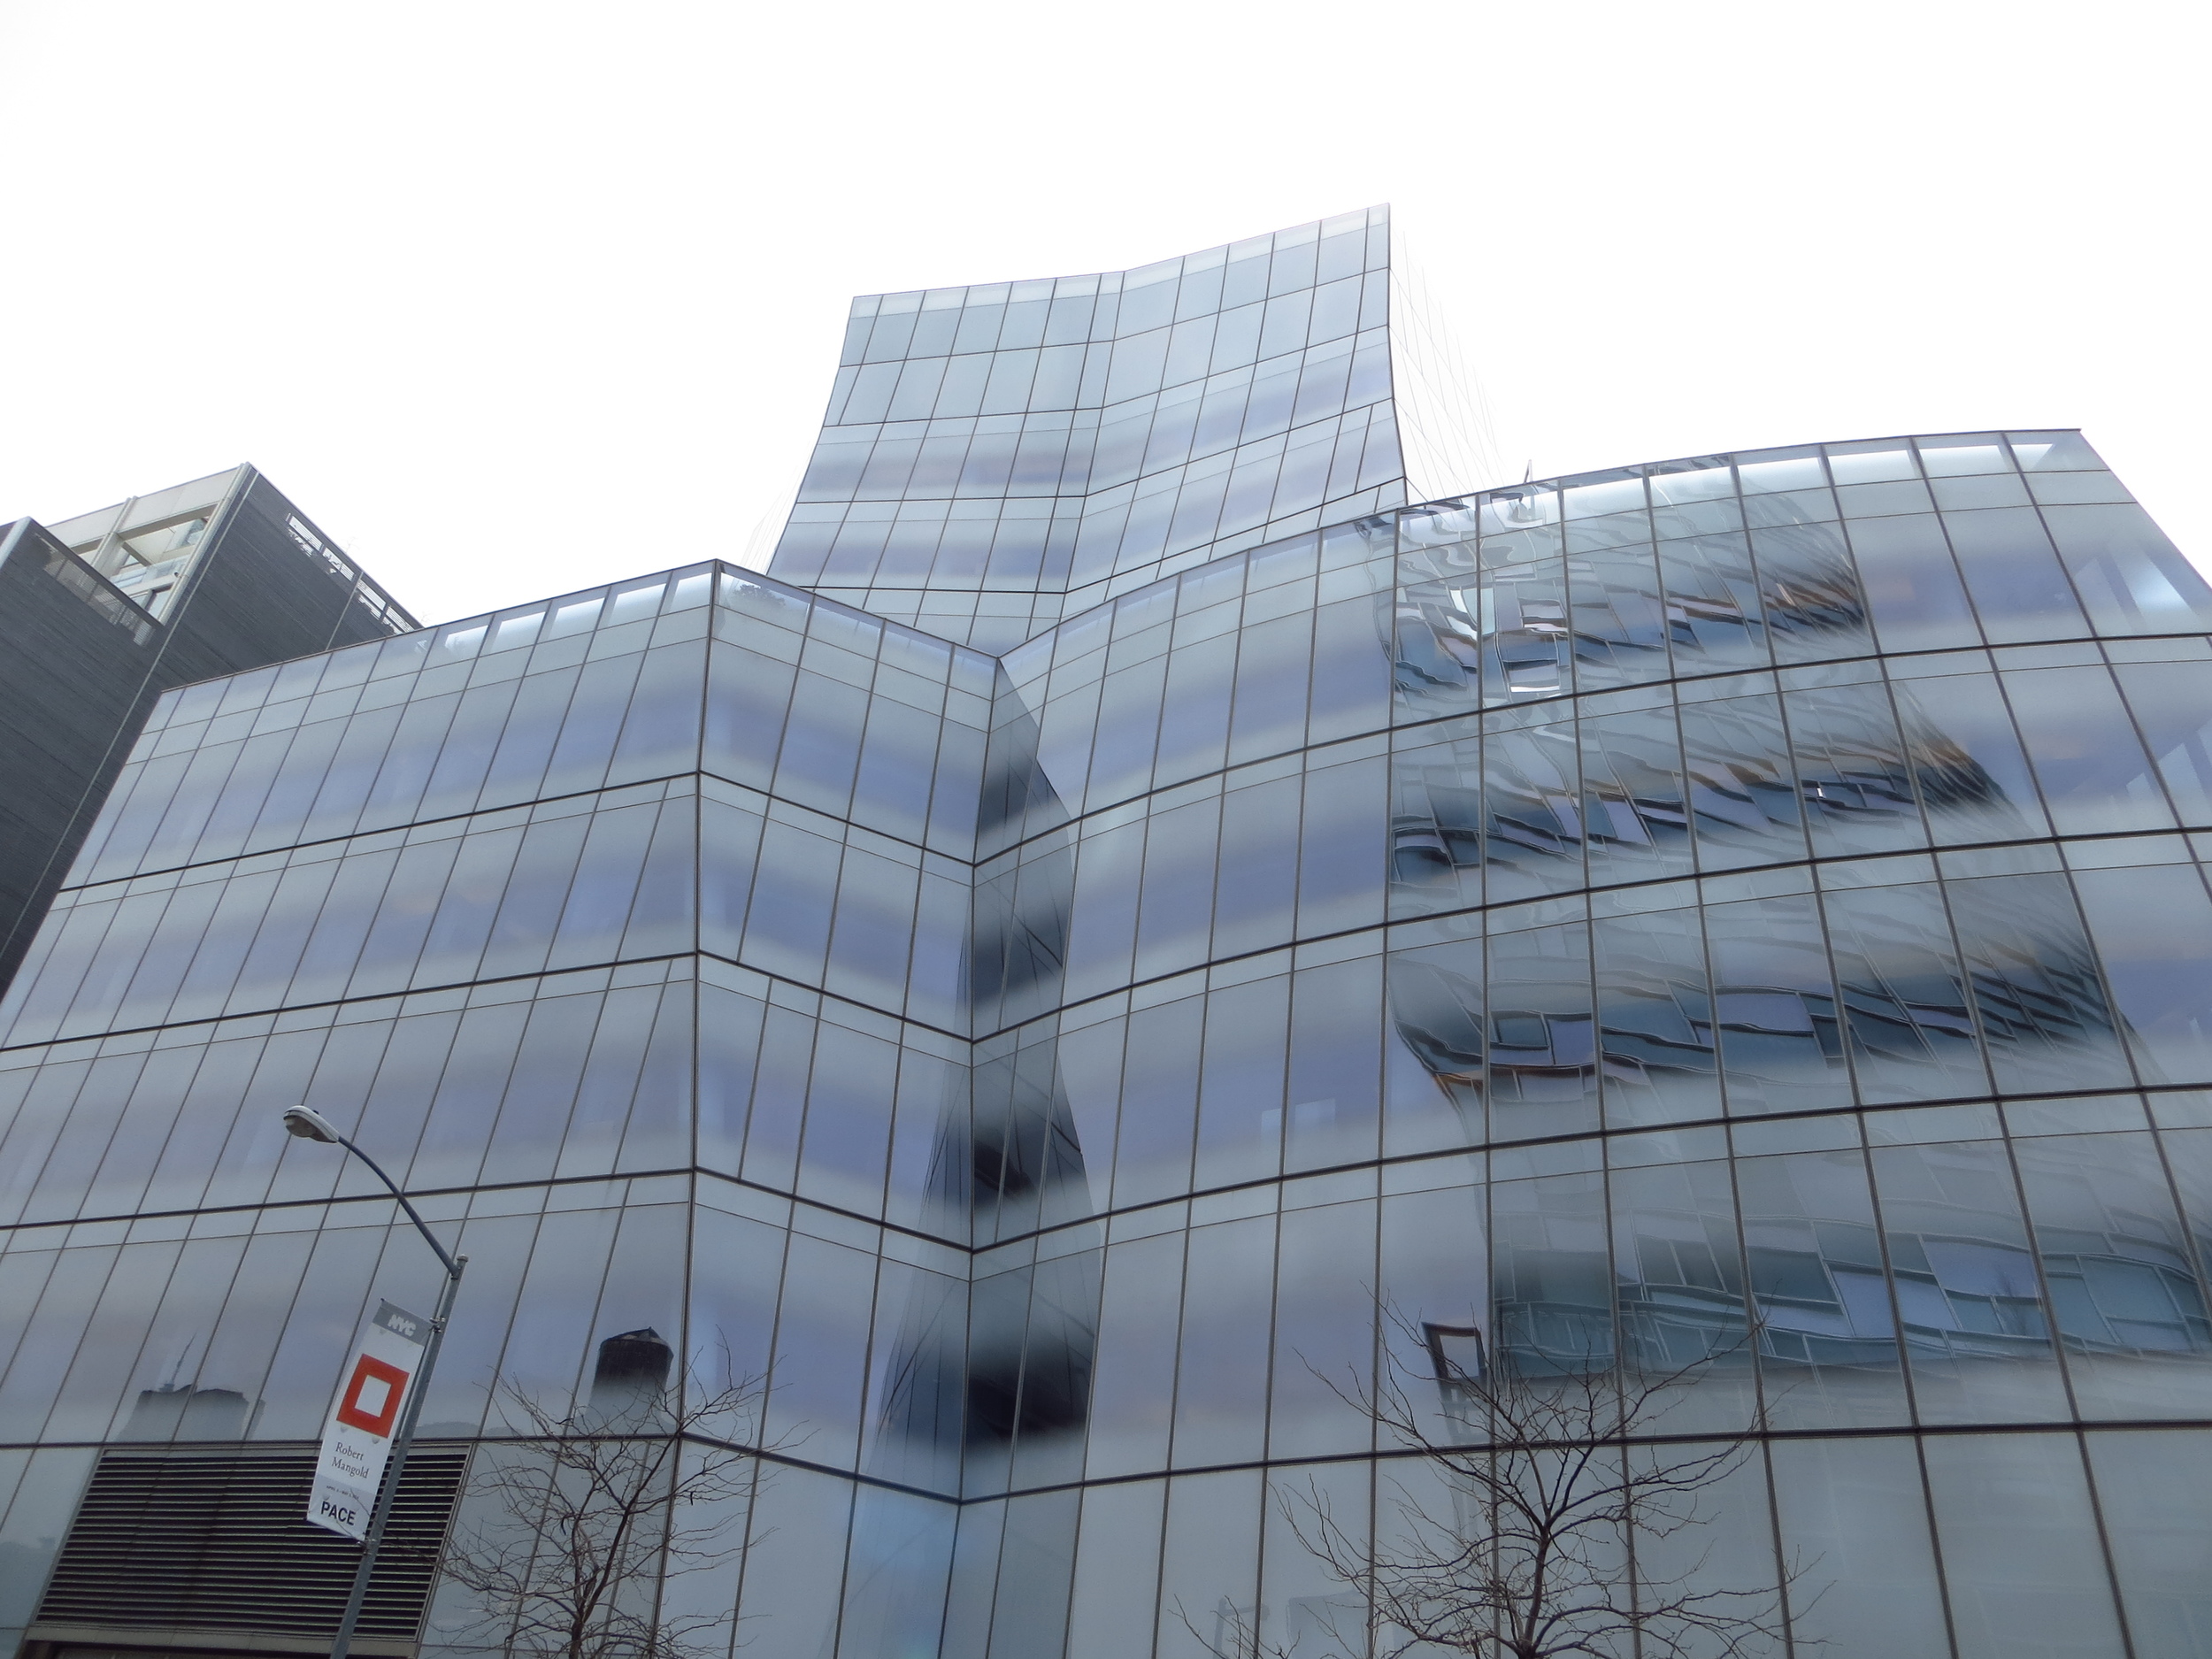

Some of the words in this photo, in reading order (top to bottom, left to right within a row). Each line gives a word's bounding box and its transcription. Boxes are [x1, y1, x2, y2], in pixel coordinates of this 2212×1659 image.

[388, 1314, 416, 1336] NYC
[335, 1441, 364, 1461] Robert
[332, 1456, 369, 1479] Mangold
[321, 1501, 356, 1525] PACE
